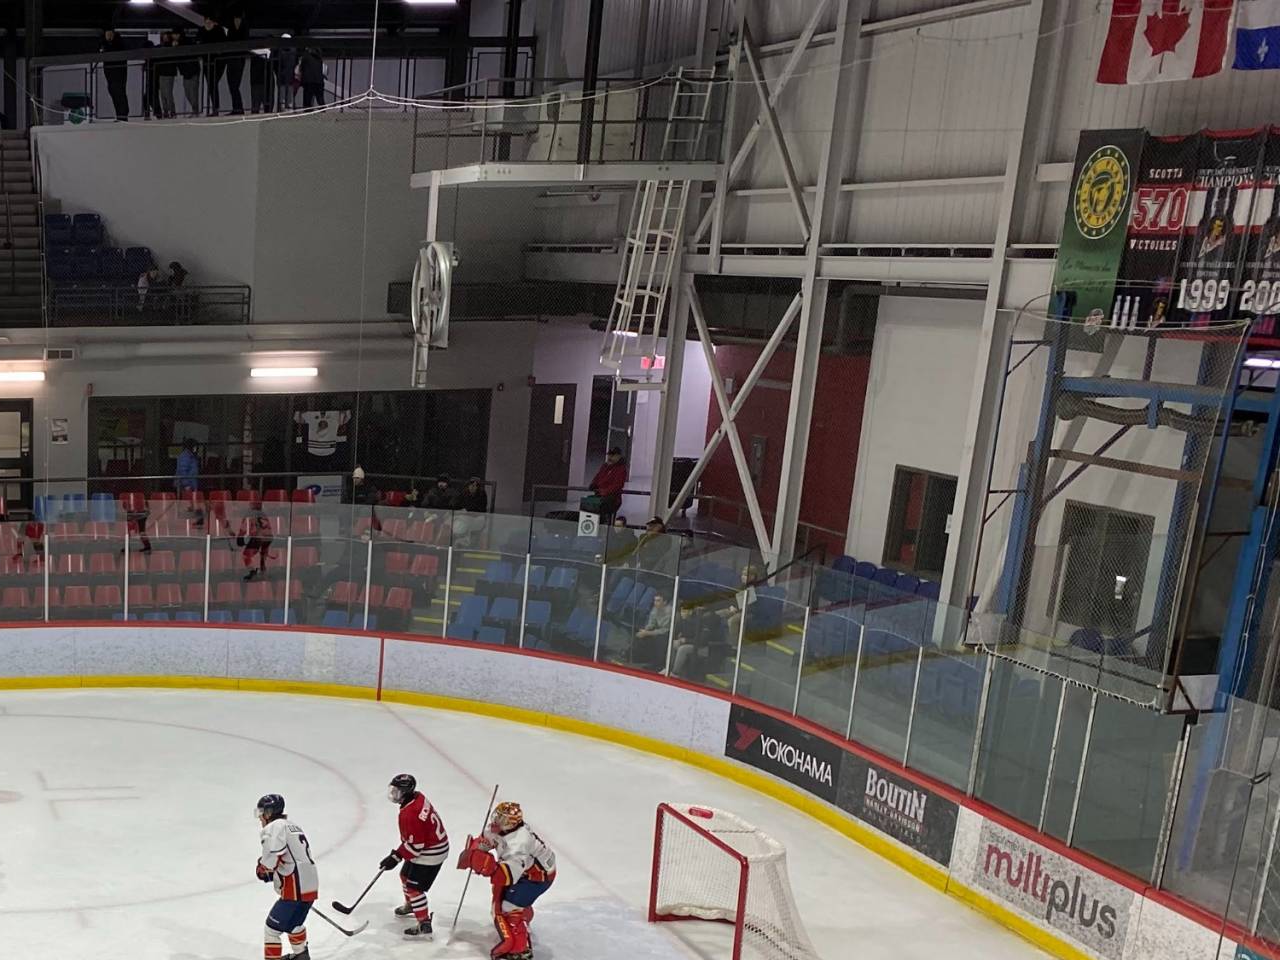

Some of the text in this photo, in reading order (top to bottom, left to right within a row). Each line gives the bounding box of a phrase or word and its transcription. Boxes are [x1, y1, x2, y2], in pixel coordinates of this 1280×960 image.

[1132, 187, 1189, 231] 570
[1177, 279, 1230, 312] 1999
[760, 734, 832, 787] YOKOHAMA
[865, 767, 927, 823] BOUTIN
[984, 843, 1117, 939] multiplus
